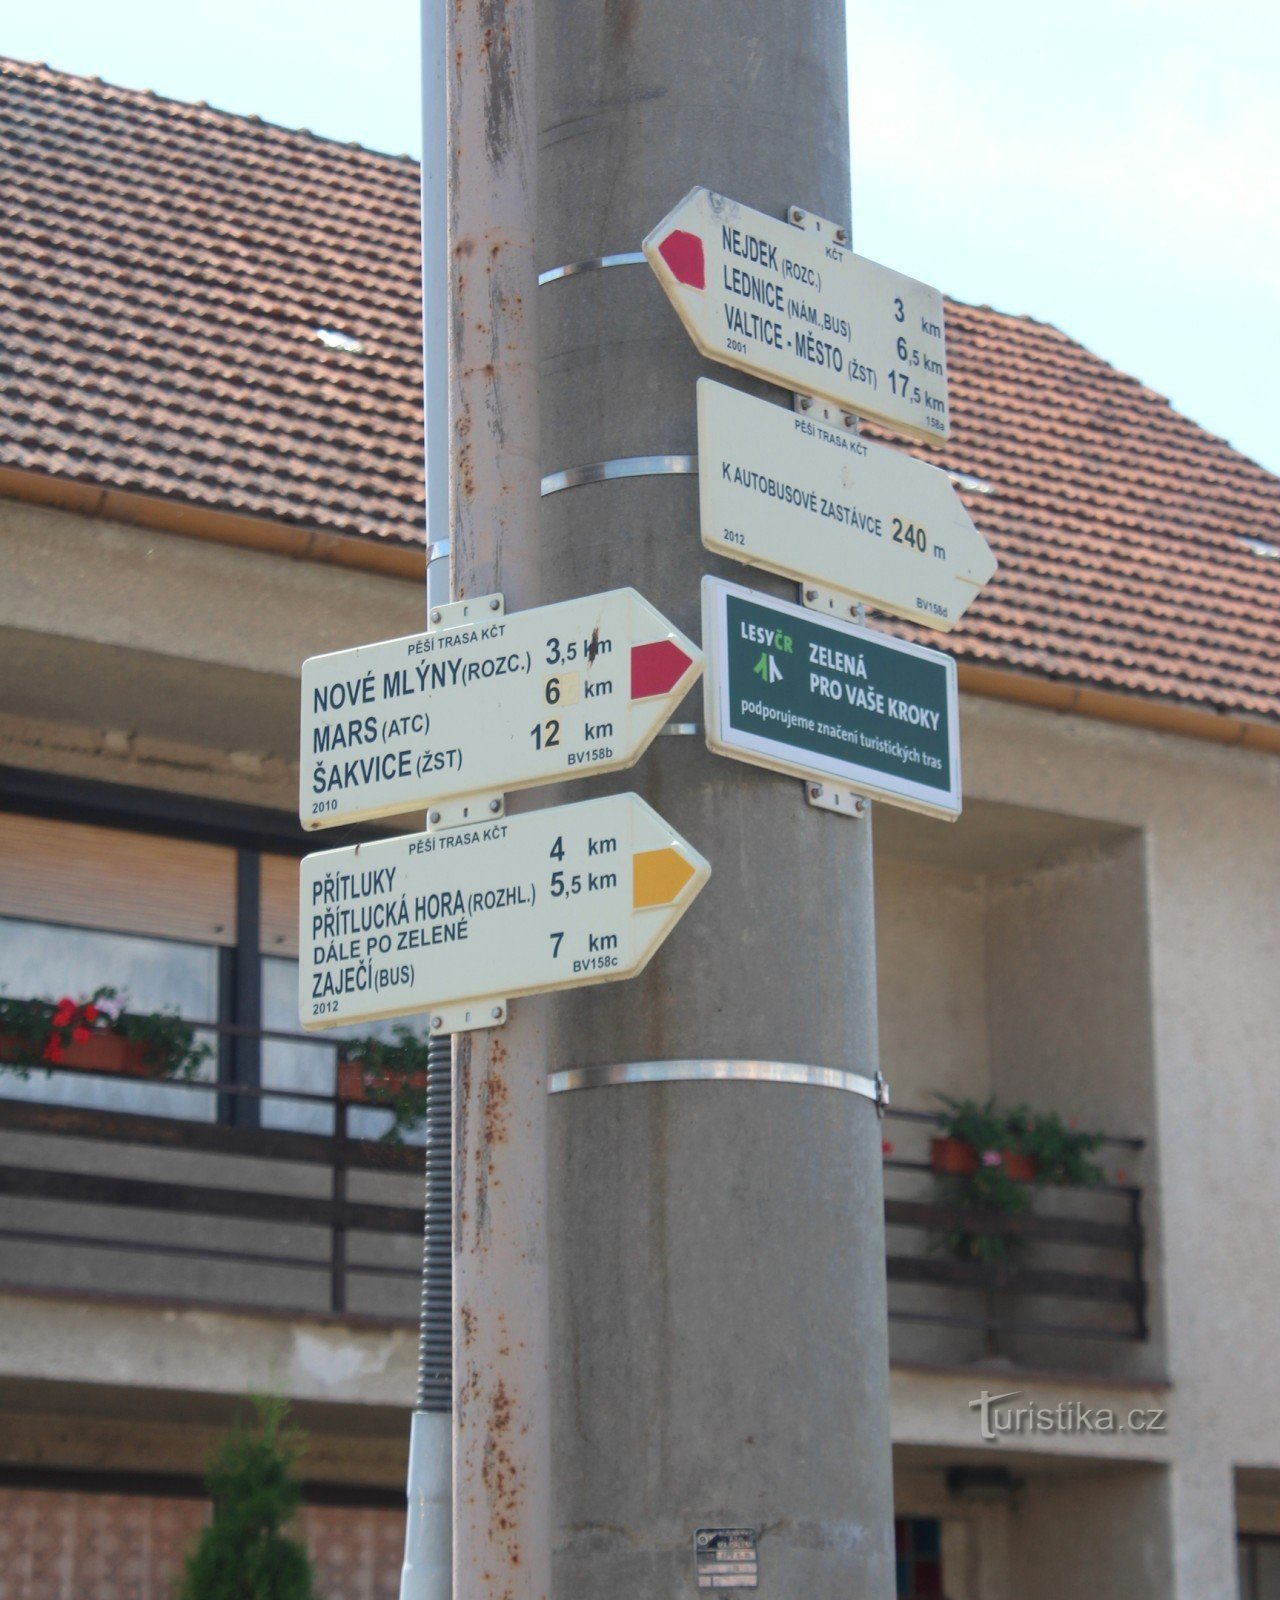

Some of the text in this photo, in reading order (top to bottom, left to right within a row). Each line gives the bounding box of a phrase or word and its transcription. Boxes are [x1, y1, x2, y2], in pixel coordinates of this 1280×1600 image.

[826, 247, 843, 262] KČT
[722, 225, 941, 338] NEJDEK (ROZC.) 3 km
[724, 264, 784, 312] LEDNICE
[897, 337, 920, 366] 6,5
[924, 354, 943, 376] km
[724, 303, 783, 349] VALTICE
[795, 330, 843, 372] MĚSTO
[848, 358, 877, 390] (ŽST)
[888, 369, 921, 403] 17,5
[925, 391, 945, 413] km
[727, 337, 747, 354] 2001
[795, 419, 868, 457] PĚŠÍ TRASA KČT
[722, 462, 946, 560] K AUTOBUSOVÉ ZASTÁVCE 240 m
[724, 529, 745, 546] 2012
[916, 597, 948, 618] BV158d
[407, 625, 506, 656] PĚŠÍ TRASA KČT
[313, 671, 375, 714] NOVÉ
[545, 638, 577, 666] 3,5
[583, 638, 612, 659] km
[809, 643, 867, 679] ZELENÁ
[313, 678, 613, 753] MARS (ATC) 6 km
[810, 673, 940, 731] PRO VAŠE KROKY
[741, 699, 942, 770] podporujeme značení turistických tras
[312, 720, 613, 793] ŠAKVICE (ŽST) 12 km
[567, 748, 613, 766] BV158b
[312, 800, 338, 814] 2010
[409, 825, 508, 855] PĚŠÍ TRASA KČT
[312, 836, 617, 906] PŘÍTLUKY 4 km
[312, 871, 617, 941] PŘÍTLUCKÁ HORA (ROZHL.) 5,5 km
[313, 920, 468, 965] DÁLE PO ZELENÉ
[550, 932, 564, 959] 7
[588, 933, 617, 952] km
[573, 956, 618, 973] BV158c
[312, 1000, 338, 1015] 2012
